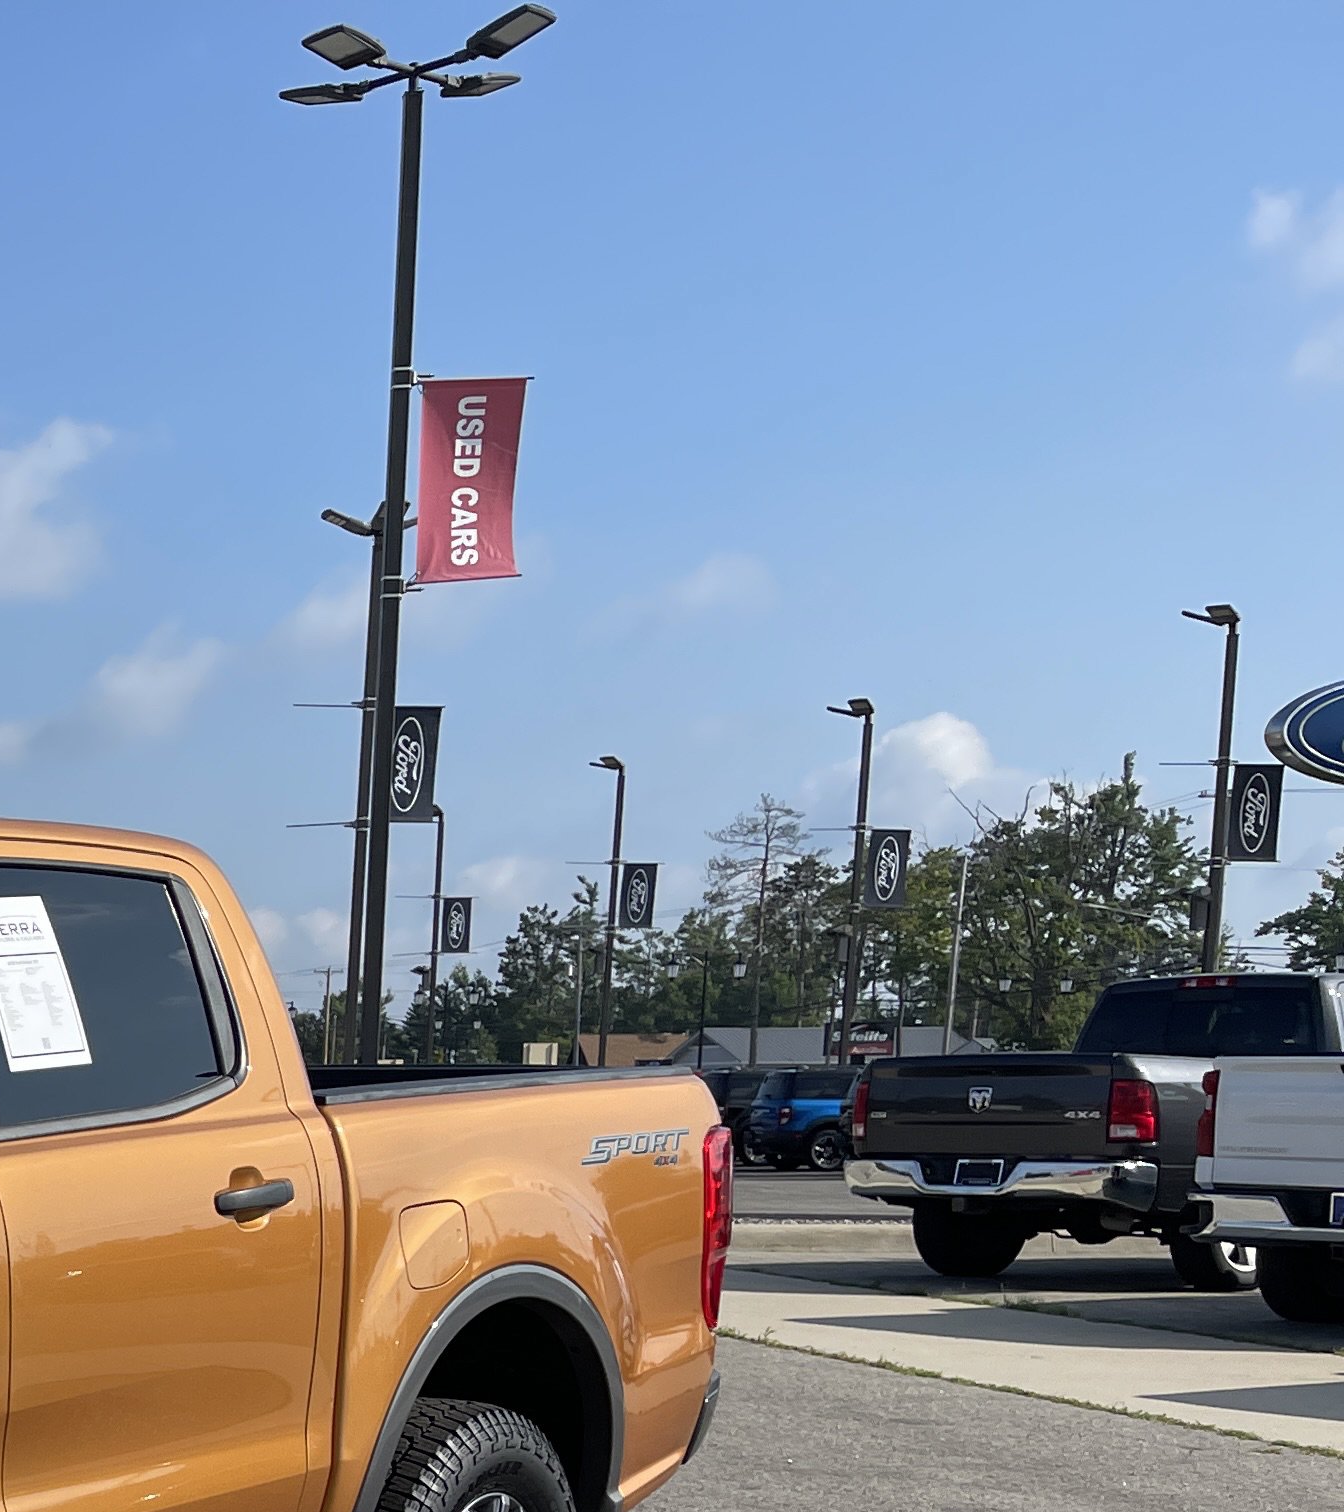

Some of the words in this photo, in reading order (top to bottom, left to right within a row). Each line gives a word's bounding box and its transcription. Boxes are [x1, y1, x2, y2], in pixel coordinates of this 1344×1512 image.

[452, 395, 488, 478] USED
[450, 486, 479, 567] CARS
[393, 734, 421, 795] Ford
[1242, 787, 1267, 838] Ford
[877, 848, 896, 889] Ford
[631, 878, 647, 913] Ford
[581, 1128, 690, 1166] SPORT
